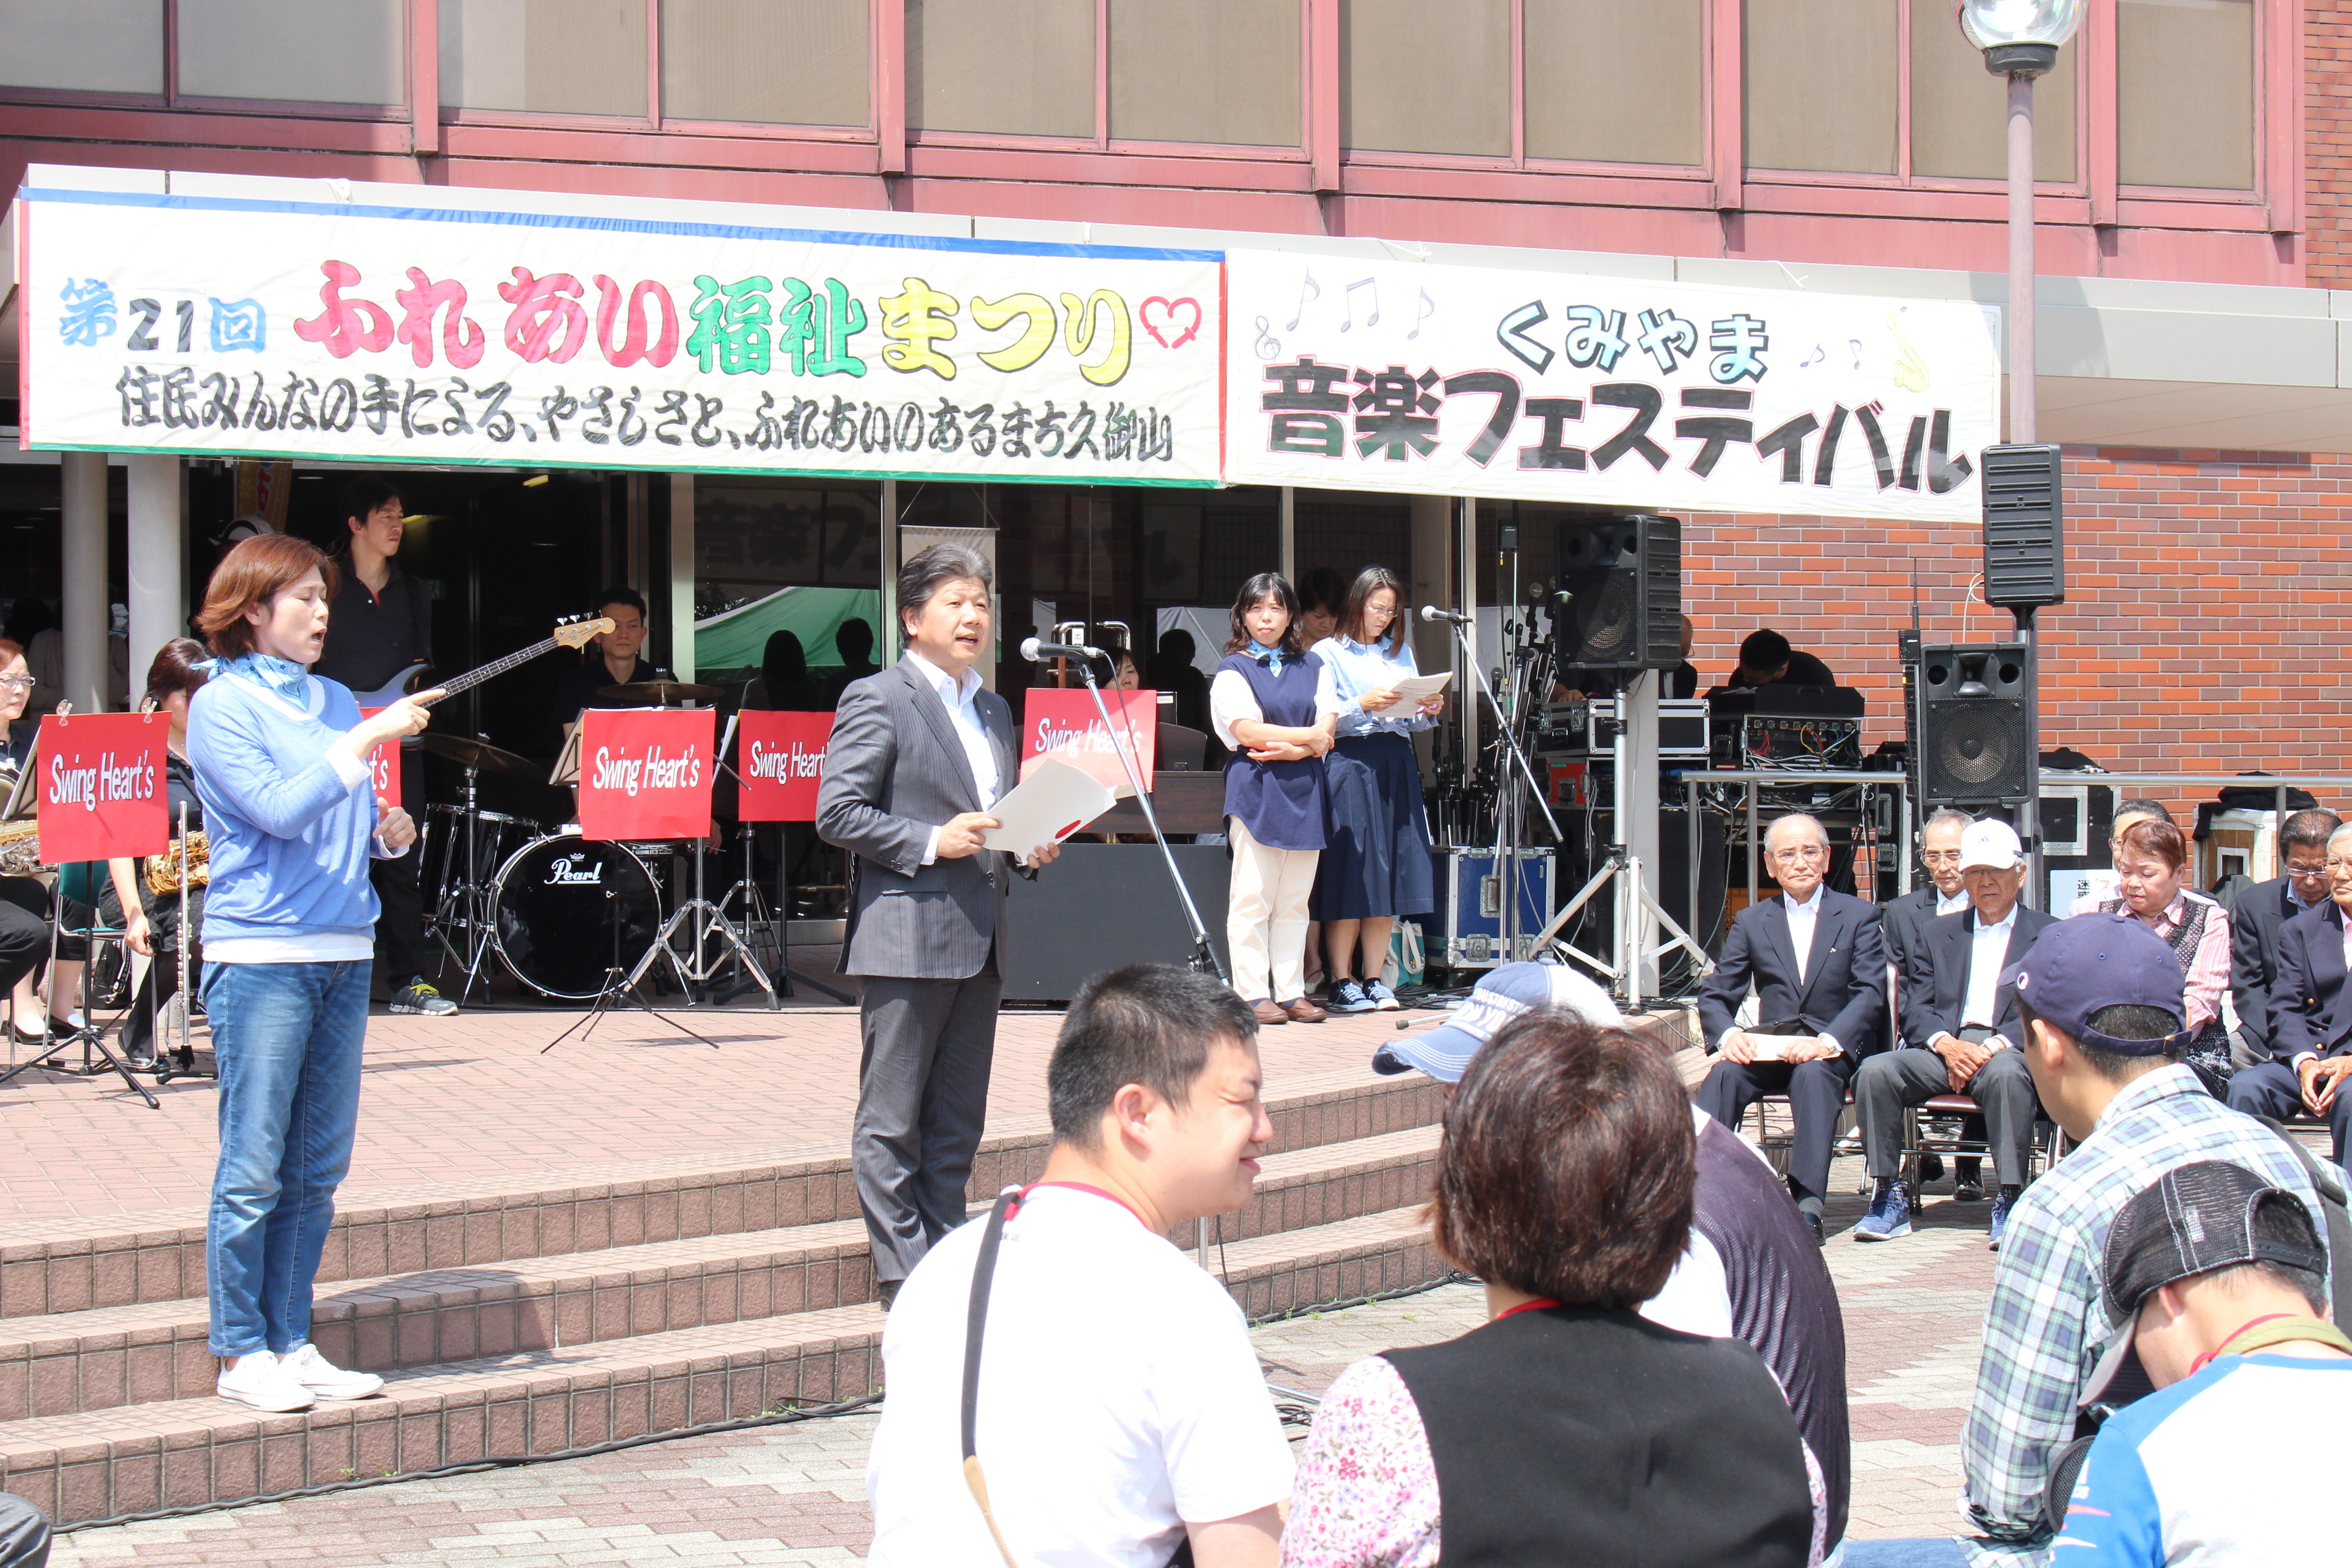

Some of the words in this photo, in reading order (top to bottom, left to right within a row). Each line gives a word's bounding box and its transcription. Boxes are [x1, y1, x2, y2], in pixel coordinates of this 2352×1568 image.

[59, 277, 269, 355] 第21回
[294, 260, 1132, 387] ふれあい福祉まつり
[1496, 298, 1769, 386] くみやま
[114, 364, 1174, 463] 住民みんなの手による、やさしさと、ふれあいのあるまち久御山
[1259, 354, 1976, 495] 音楽フェスティバル
[750, 740, 789, 785] Swing
[1035, 717, 1083, 759] Swing
[1083, 719, 1142, 754] Heart's
[49, 753, 97, 812] Swing
[100, 750, 154, 802] Heart's
[593, 746, 643, 797] Swing
[642, 744, 701, 789] Heart's
[544, 858, 603, 884] Pearl
